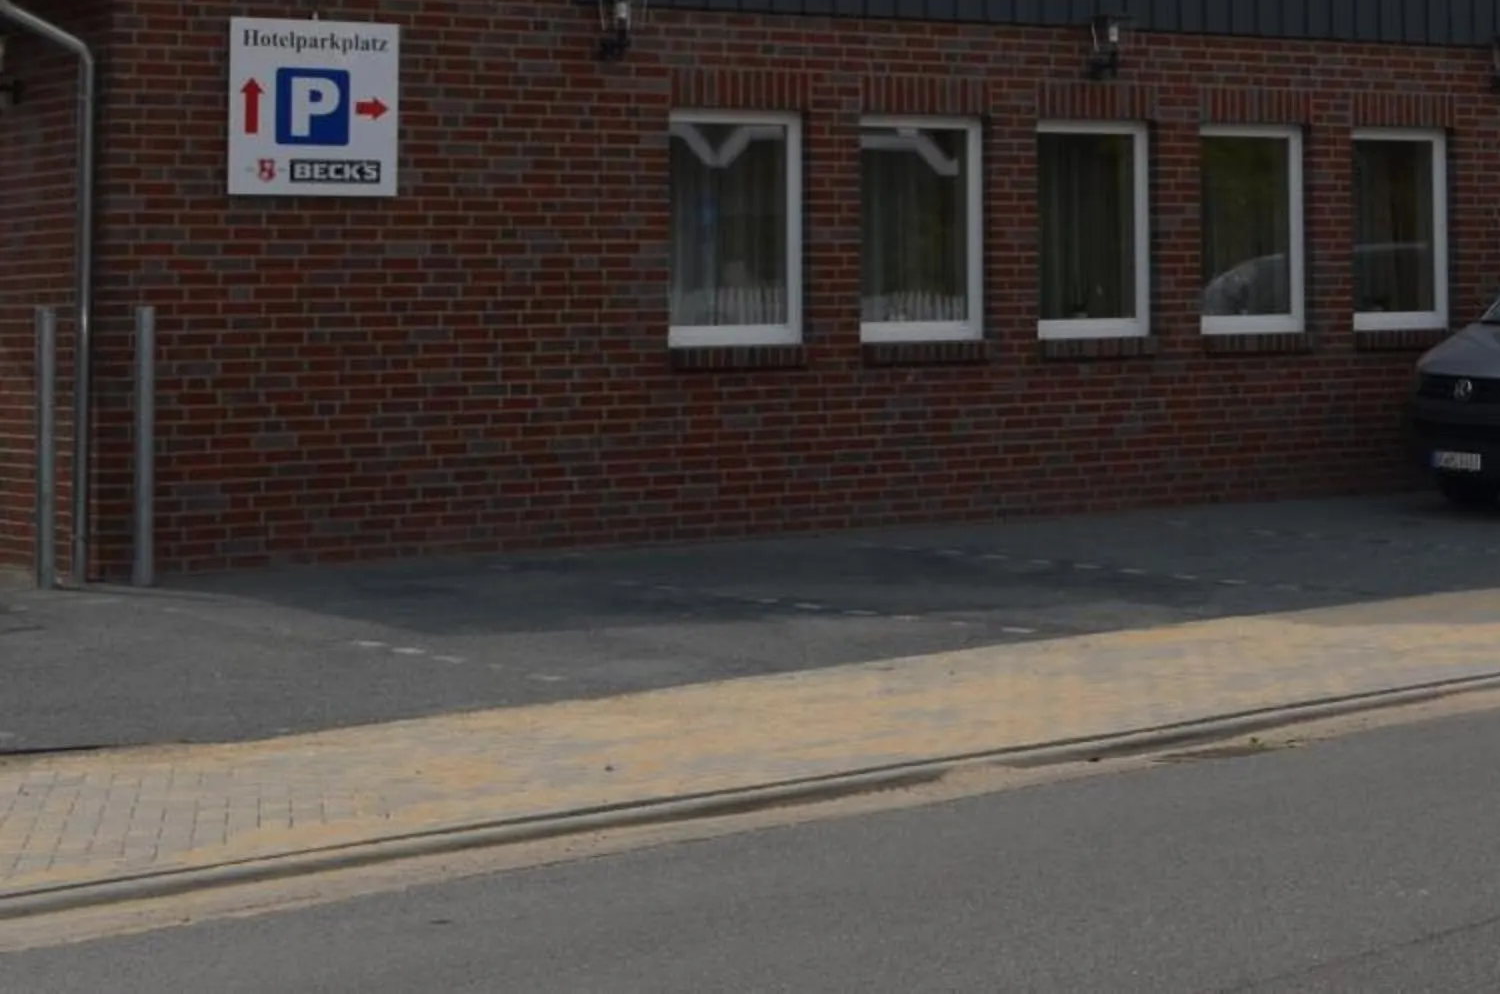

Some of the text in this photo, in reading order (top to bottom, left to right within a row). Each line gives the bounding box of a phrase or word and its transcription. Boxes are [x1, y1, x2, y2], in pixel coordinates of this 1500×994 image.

[242, 29, 390, 55] Hotelparkplatz
[290, 76, 341, 137] P
[293, 163, 378, 180] BECK'S
